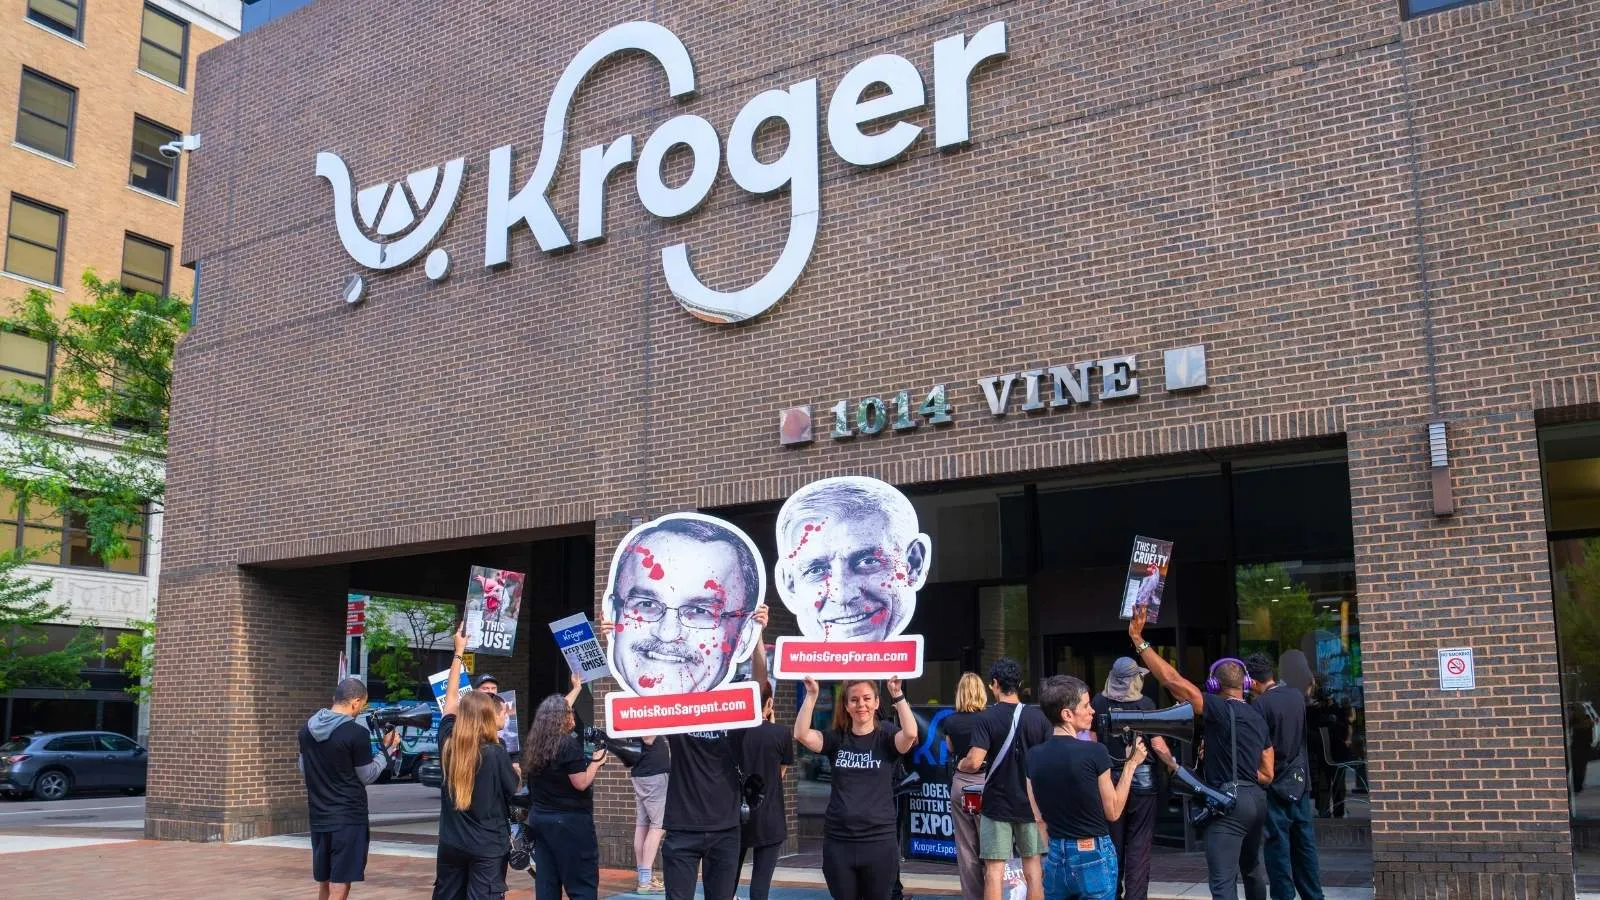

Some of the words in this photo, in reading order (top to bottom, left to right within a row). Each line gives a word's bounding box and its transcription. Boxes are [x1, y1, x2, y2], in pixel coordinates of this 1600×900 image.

[485, 20, 1007, 325] Kroger
[829, 384, 954, 440] 1014
[977, 355, 1139, 416] VINE
[1136, 541, 1150, 553] THIS
[1150, 543, 1158, 553] IS
[1133, 551, 1168, 567] CRUELTY
[486, 620, 505, 632] THIS
[580, 640, 598, 652] YOUR
[581, 656, 606, 672] OMISE
[789, 650, 909, 665] whoisGregForan.com
[619, 699, 747, 720] whoisRonSargent.com
[837, 750, 872, 761] animal
[835, 759, 882, 769] EQUALITY
[913, 783, 951, 799] OGER
[910, 799, 944, 813] ROTTEN
[911, 812, 953, 836] EXPO
[914, 841, 957, 855] Kroger.Expos
